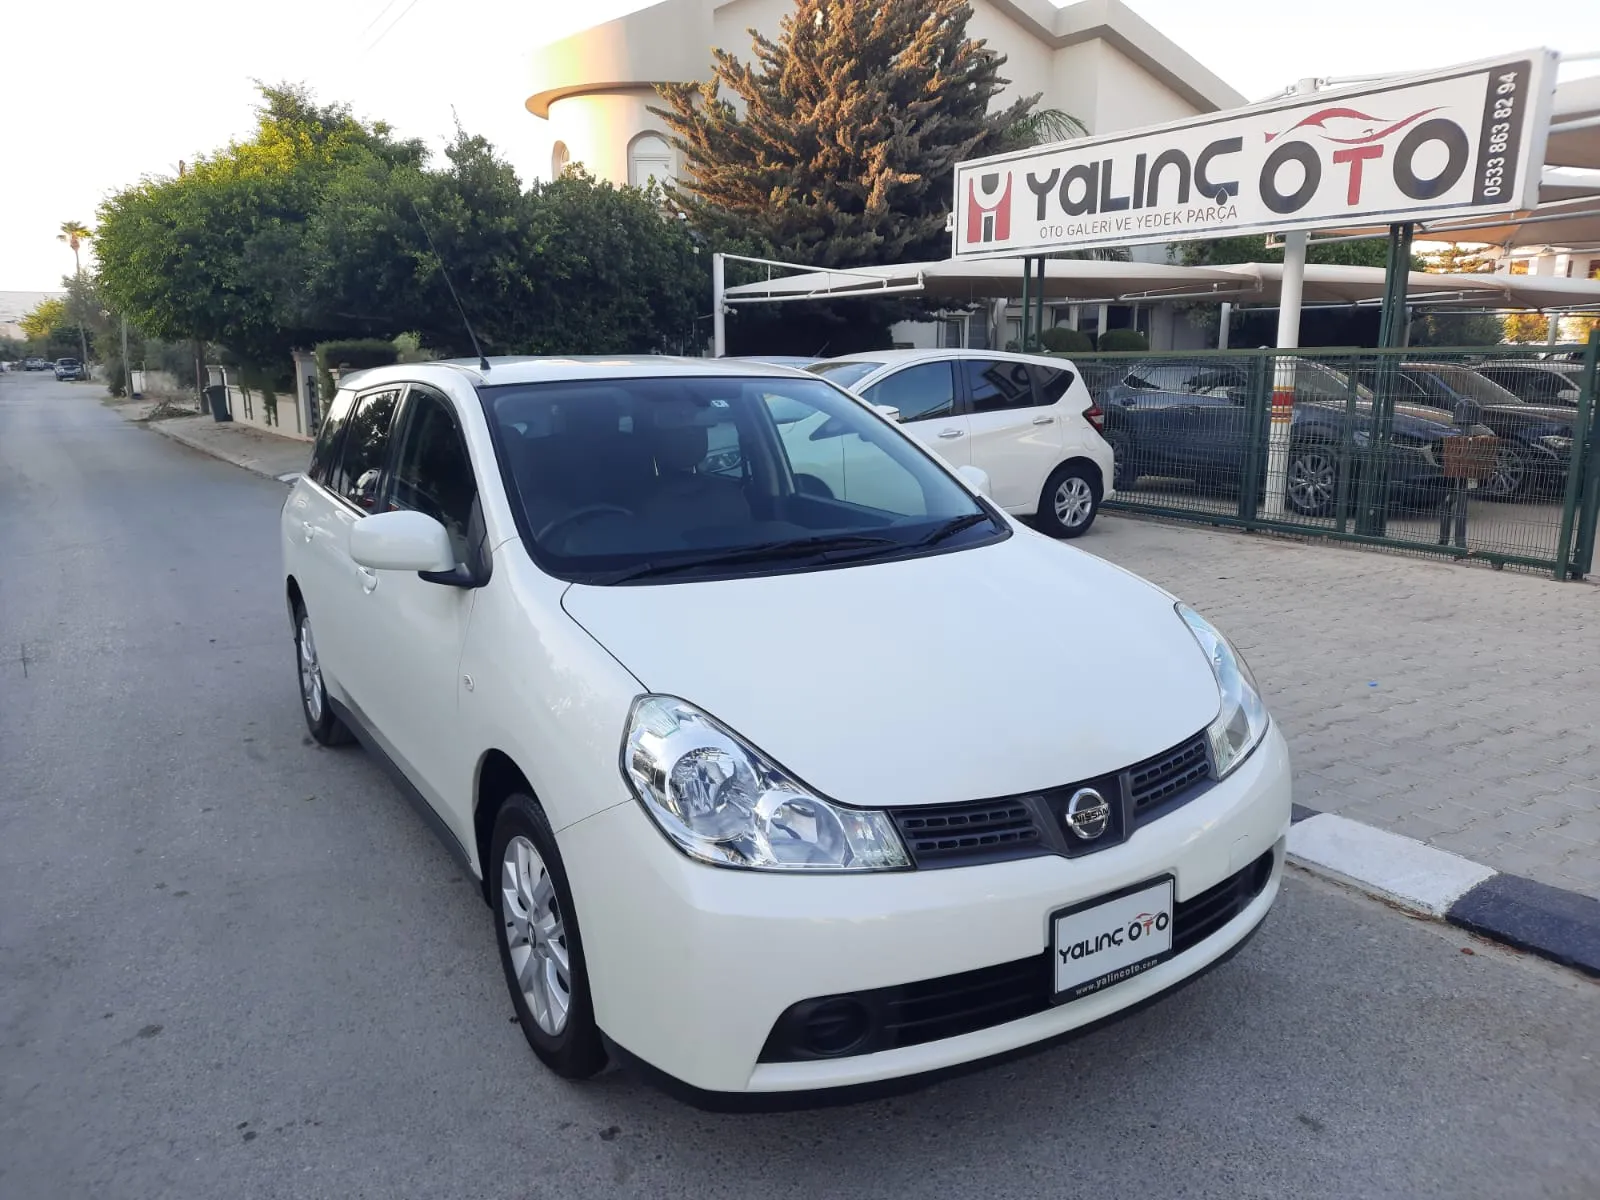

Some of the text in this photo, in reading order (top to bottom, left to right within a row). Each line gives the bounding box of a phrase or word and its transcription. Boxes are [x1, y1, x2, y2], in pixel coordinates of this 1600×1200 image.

[1483, 71, 1518, 197] 0533 863 82 94
[1259, 118, 1469, 214] OTO
[1040, 226, 1063, 239] OTO
[1116, 215, 1132, 230] VE
[1136, 210, 1182, 229] YEDEK
[1186, 204, 1238, 225] PARÇA
[1072, 807, 1109, 824] NISSAN
[1128, 912, 1169, 941] OTO
[1075, 959, 1158, 995] www.yalincoto.com
